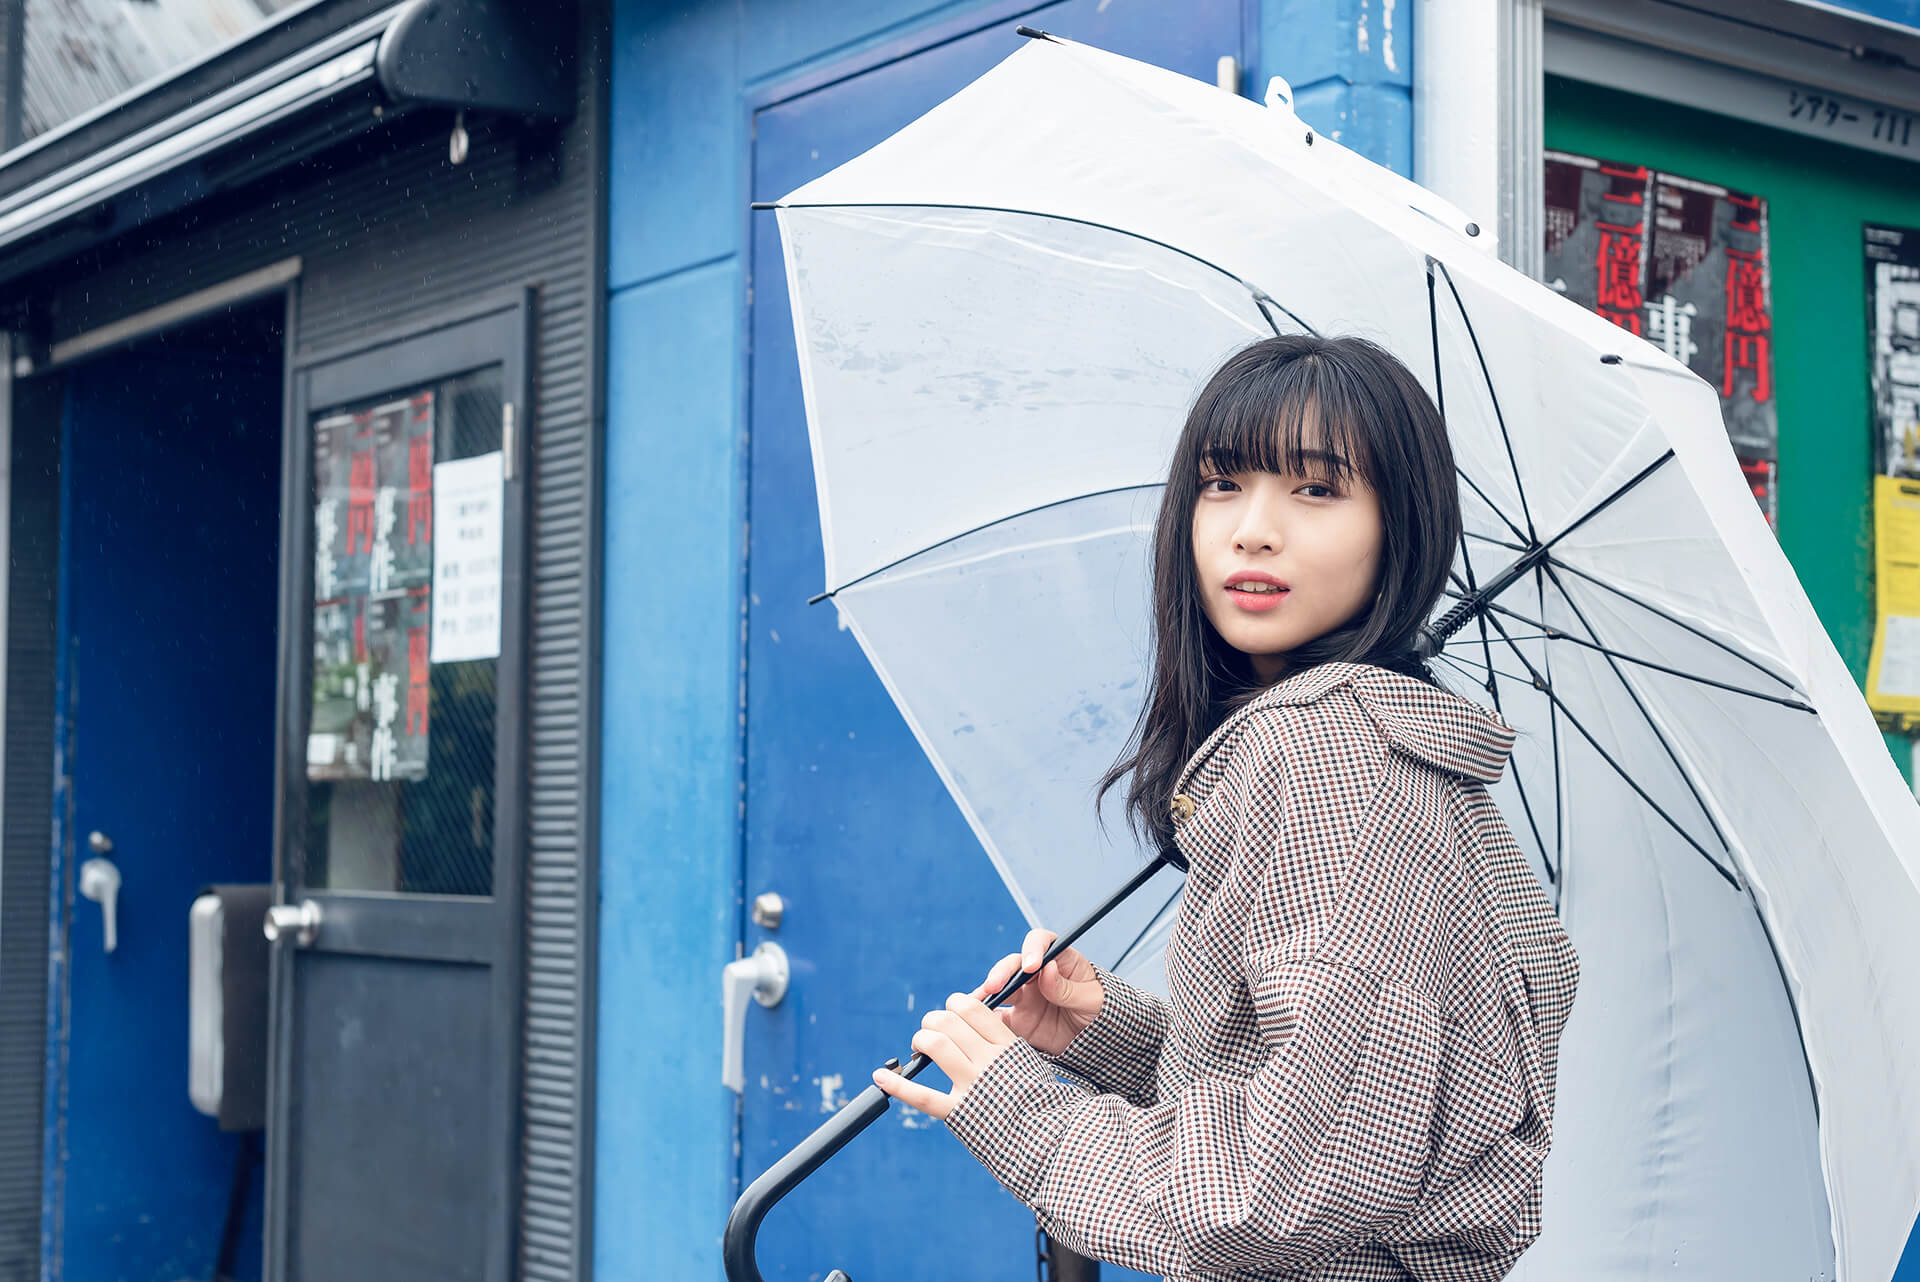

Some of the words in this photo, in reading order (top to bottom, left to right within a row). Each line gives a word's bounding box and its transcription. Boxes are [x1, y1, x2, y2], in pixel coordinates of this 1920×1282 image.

[1789, 89, 1858, 128] シアター
[1873, 109, 1911, 146] 711
[1723, 196, 1772, 402] 三億円
